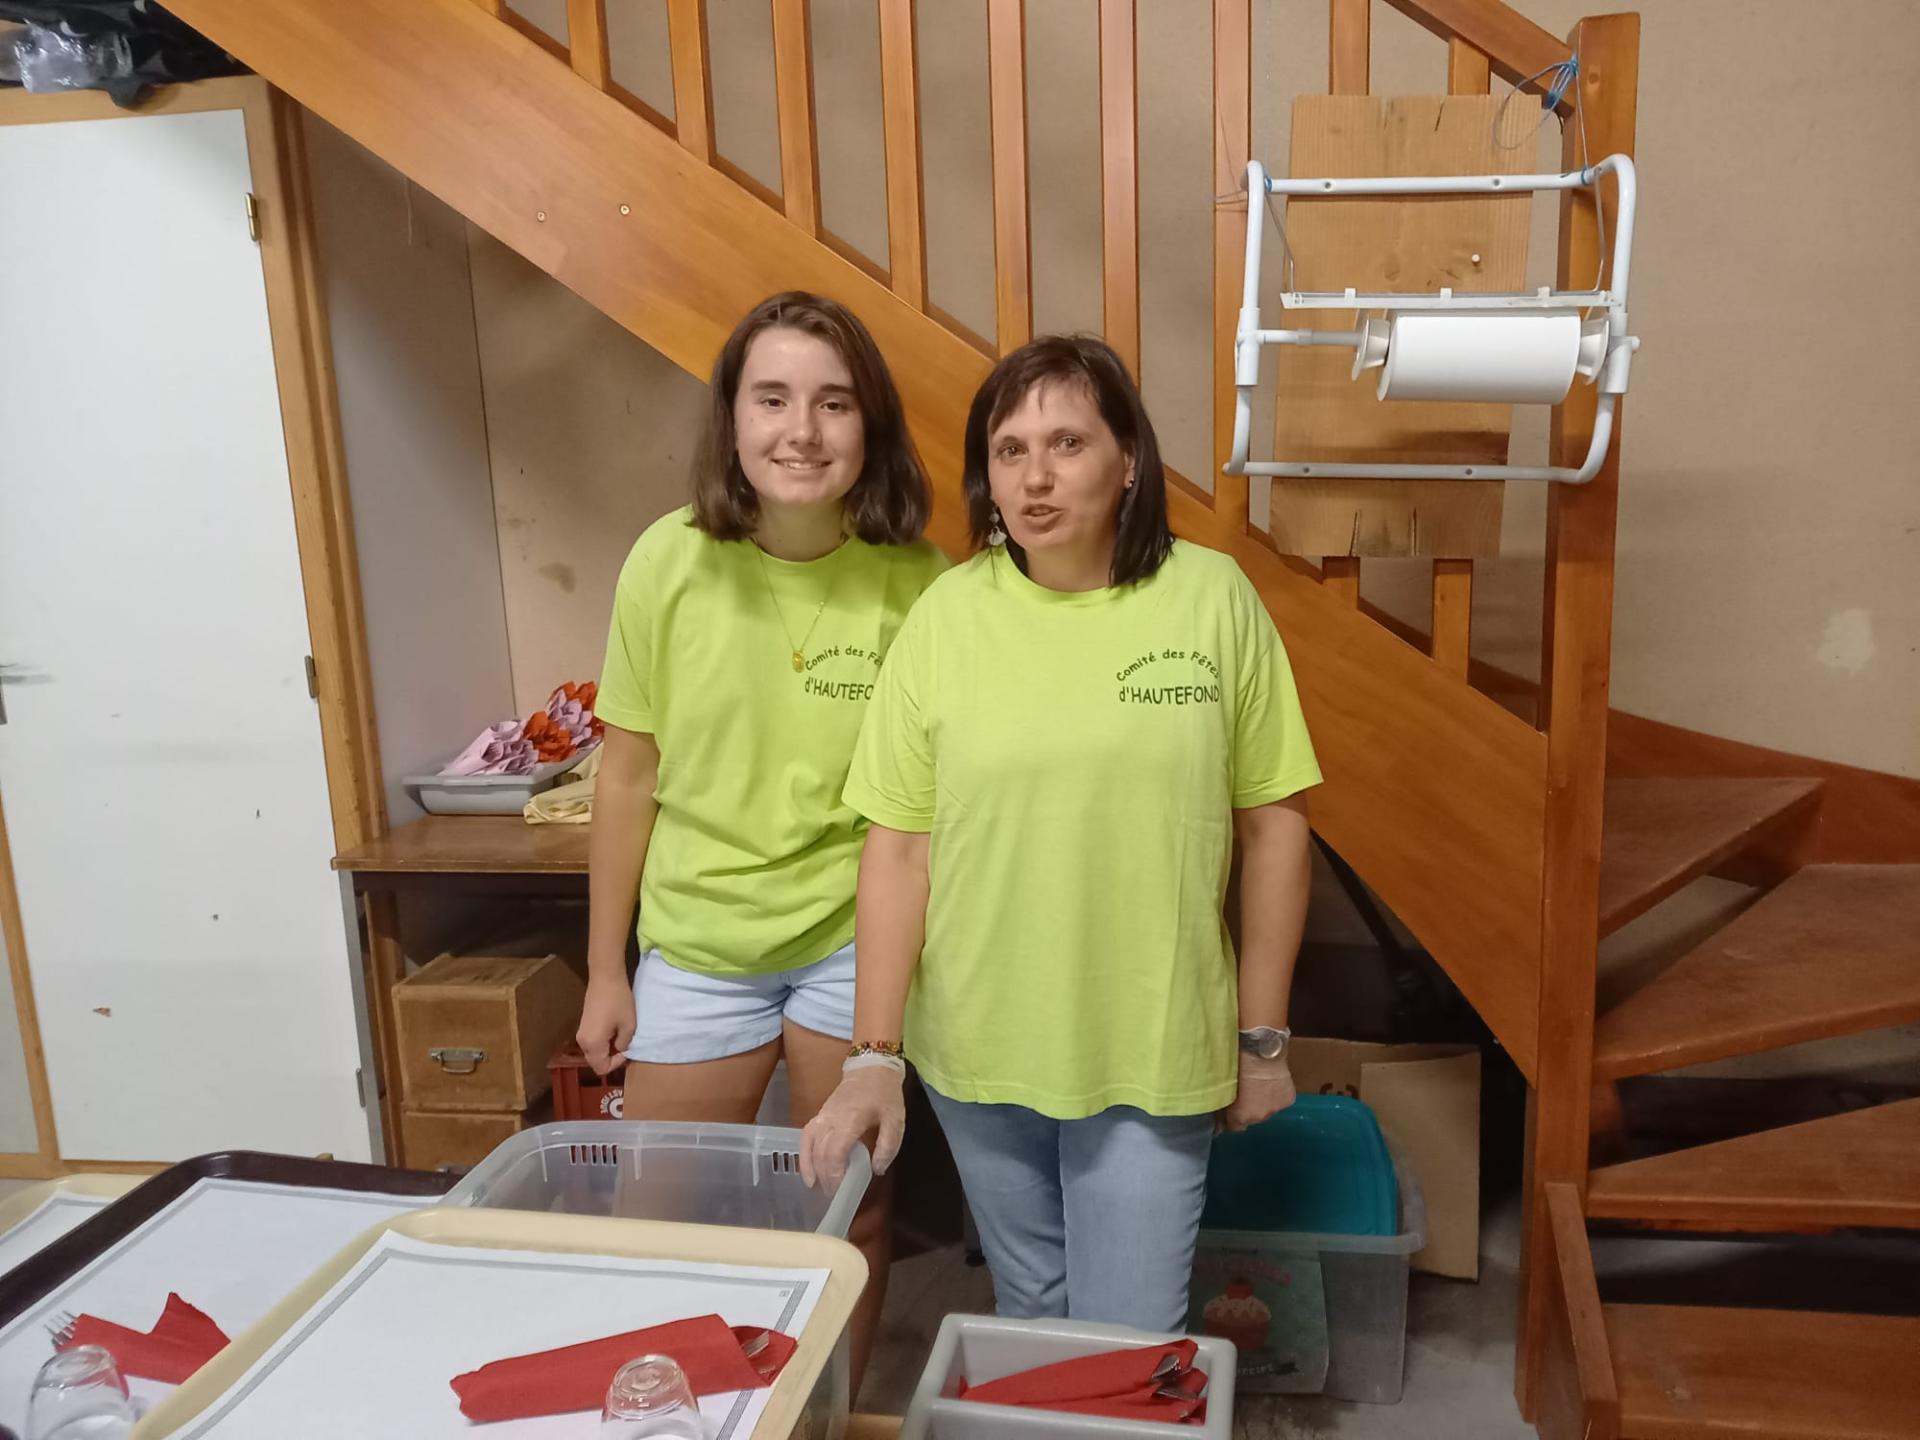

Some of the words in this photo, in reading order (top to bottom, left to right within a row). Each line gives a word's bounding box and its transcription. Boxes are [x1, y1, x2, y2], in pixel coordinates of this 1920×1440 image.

[805, 645, 840, 671] Comité
[845, 645, 864, 657] des
[1116, 651, 1156, 681] Comité
[1162, 648, 1185, 660] des
[1190, 651, 1220, 679] Fêtes
[804, 676, 874, 701] d'HAUTEFO
[1119, 685, 1220, 705] d'HAUTEFOND
